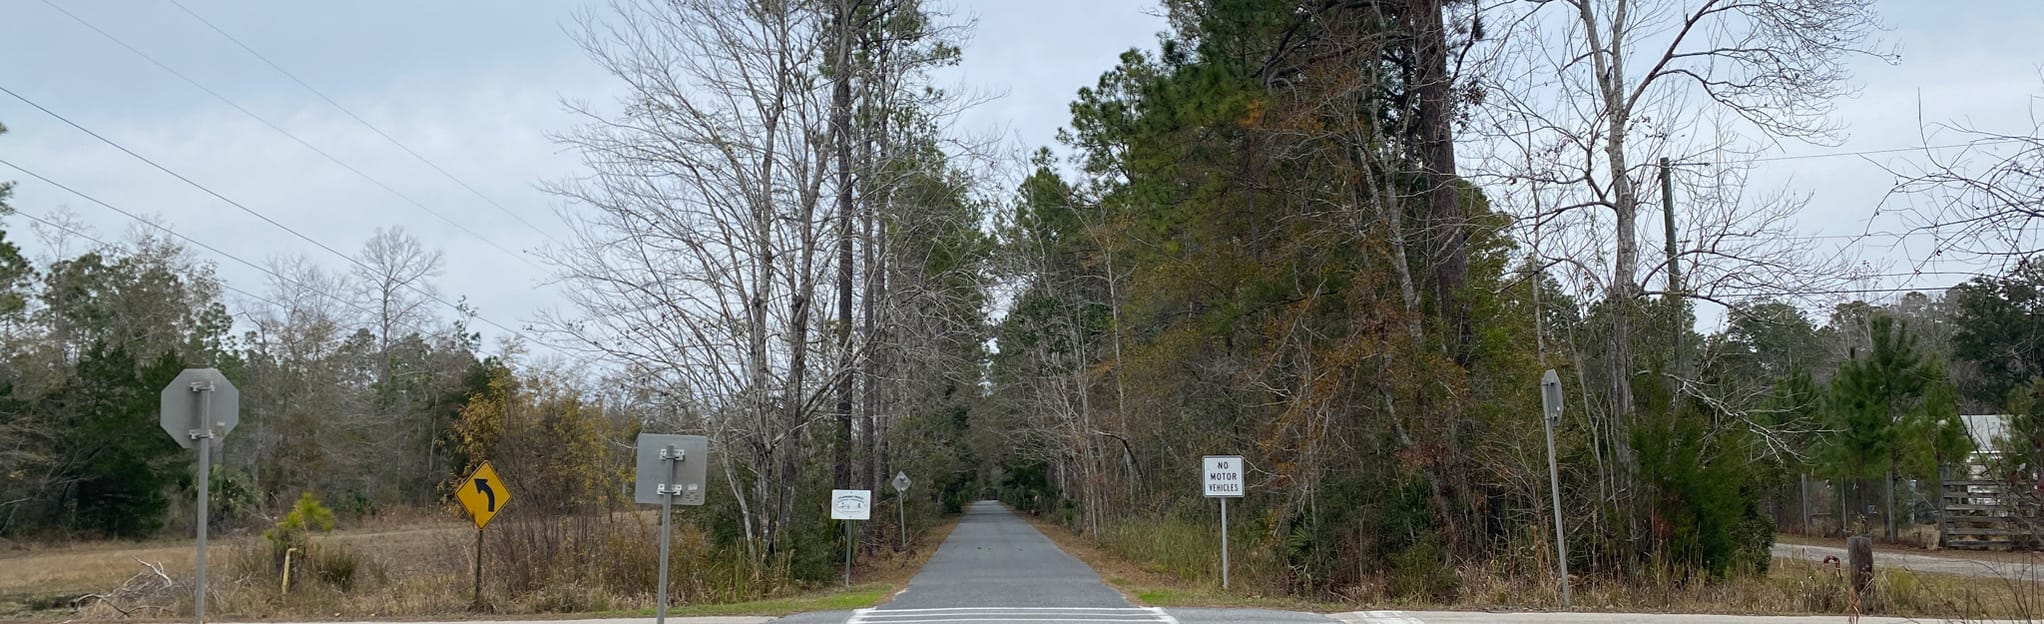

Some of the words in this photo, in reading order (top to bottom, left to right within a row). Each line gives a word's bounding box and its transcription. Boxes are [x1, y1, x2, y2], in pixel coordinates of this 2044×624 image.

[1217, 461, 1229, 470] NO
[1210, 472, 1237, 480] MOTOR
[1208, 483, 1239, 492] VEHICLES
